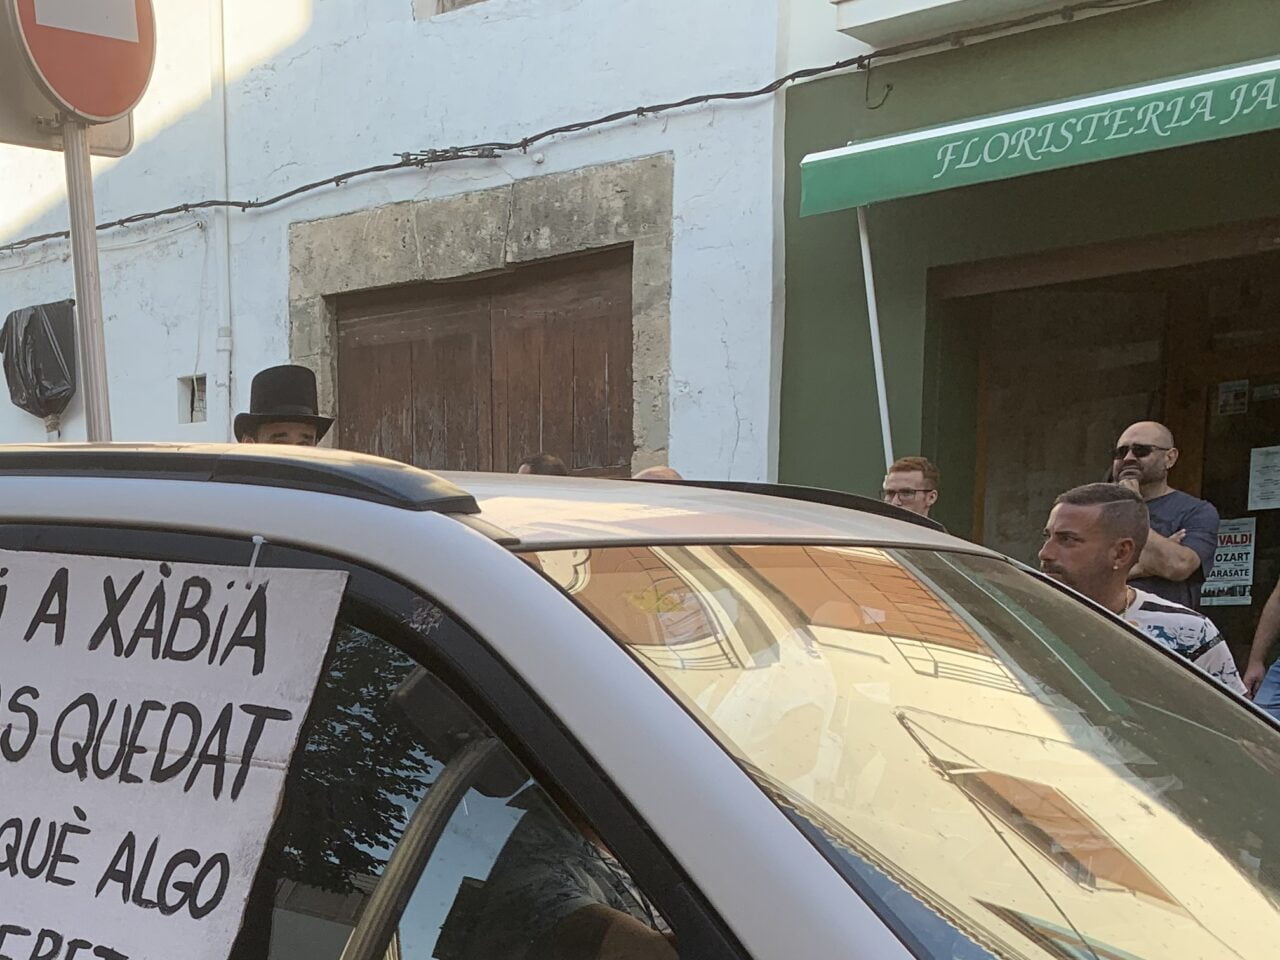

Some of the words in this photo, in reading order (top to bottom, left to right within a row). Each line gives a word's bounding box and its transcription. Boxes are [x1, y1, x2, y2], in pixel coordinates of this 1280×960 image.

[932, 89, 1216, 179] FLORISTERIA
[1219, 77, 1280, 125] JA
[1210, 568, 1250, 578] ARASATE
[1215, 551, 1251, 563] OZART
[1218, 533, 1253, 546] VALDI
[24, 566, 70, 646] A
[50, 692, 294, 802] QUEDAT
[95, 831, 231, 920] ALGO
